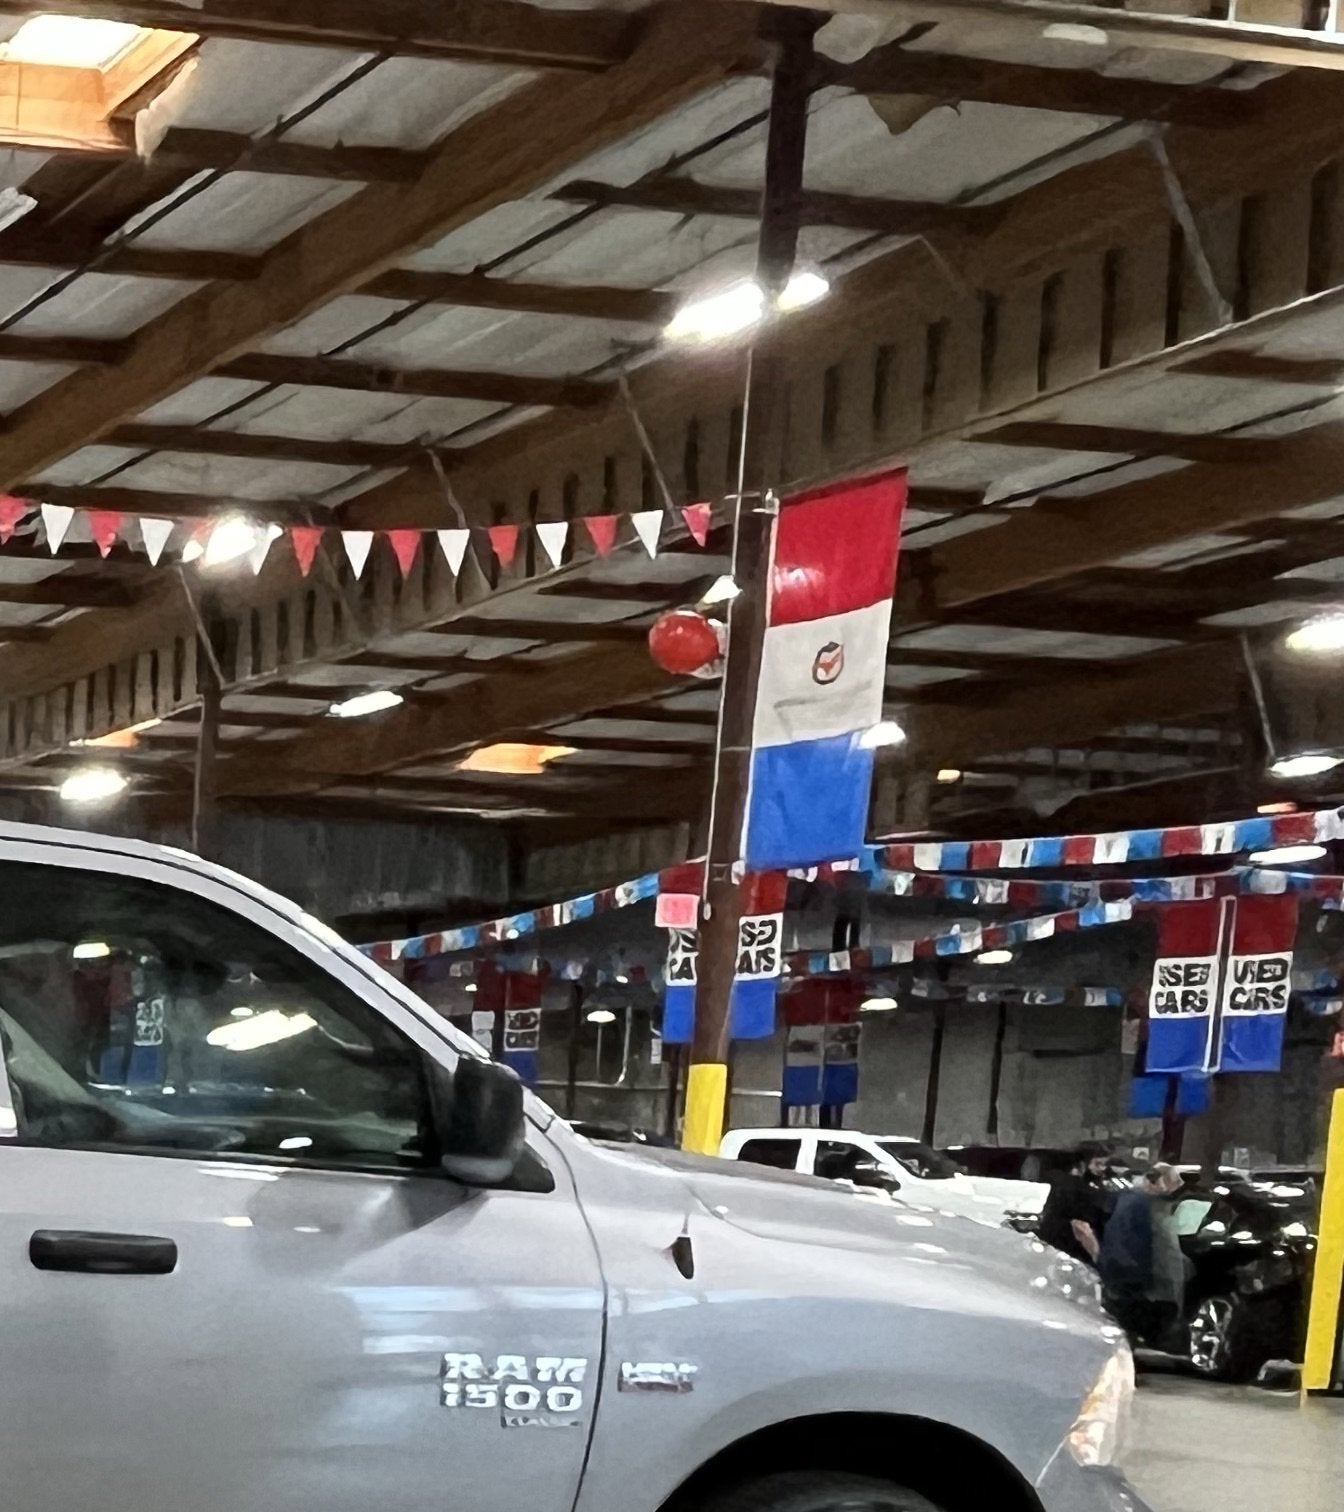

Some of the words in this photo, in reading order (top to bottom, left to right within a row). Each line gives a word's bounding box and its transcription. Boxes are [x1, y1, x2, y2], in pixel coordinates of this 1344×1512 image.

[737, 947, 775, 974] ARS
[441, 1352, 587, 1382] RAM
[441, 1382, 583, 1412] 1500
